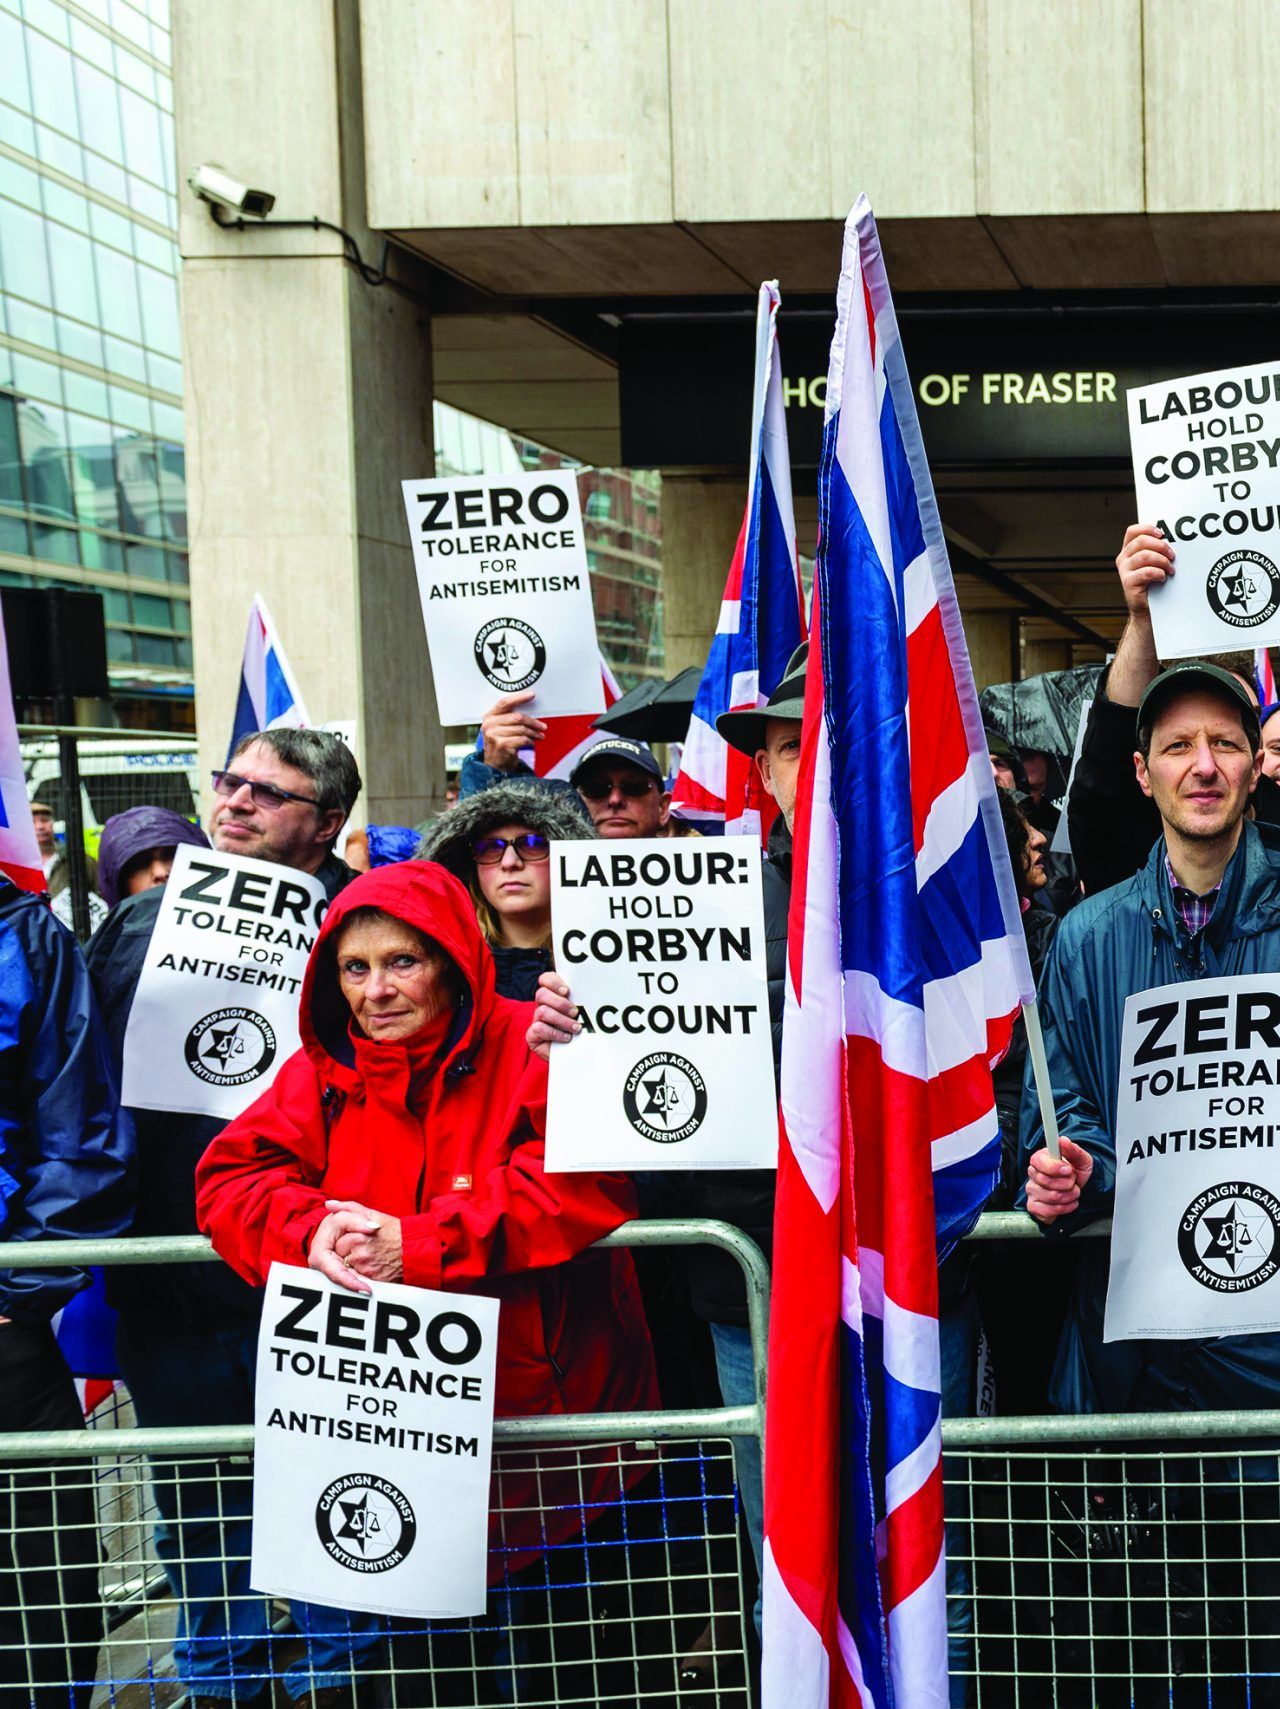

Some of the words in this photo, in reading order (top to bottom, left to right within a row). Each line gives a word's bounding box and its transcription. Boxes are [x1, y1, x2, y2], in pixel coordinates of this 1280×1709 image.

[919, 374, 970, 406] OF
[983, 372, 1117, 404] FRASER
[1188, 413, 1264, 442] HOLD
[1213, 480, 1251, 502] TO
[417, 484, 569, 532] ZERO
[422, 530, 575, 557] TOLERANCE
[480, 559, 516, 573] FOR
[1209, 552, 1244, 588] CAMPAIGN
[1246, 552, 1279, 579] AGAINST
[430, 576, 580, 600] ANTISEMITISM
[1219, 603, 1276, 626] ANTISEMITISM
[475, 619, 507, 653] CAMPAIGN
[509, 619, 542, 648] AGAINST
[487, 670, 540, 691] ANTISEMITISM
[560, 852, 748, 887] LABOUR:
[609, 896, 693, 919] HOLD
[174, 907, 314, 954] TOLERAN
[562, 927, 751, 963] CORBYN
[238, 946, 283, 966] FOR
[157, 954, 301, 994] ANTISEMIT
[638, 972, 678, 995] TO
[193, 1009, 246, 1037] CAMPAIGN
[247, 1013, 276, 1050] AGAINST
[576, 1005, 757, 1035] ACCOUNT
[190, 1060, 259, 1085] ANTISEMITISM
[626, 1054, 668, 1092] CAMPAIGN
[669, 1055, 705, 1092] AGAINST
[1209, 1097, 1264, 1117] FOR
[633, 1118, 699, 1141] ANTISEMITISM
[1183, 1184, 1239, 1231] CAMPAIGN
[1192, 1261, 1277, 1290] ANTISEMITISM
[274, 1284, 482, 1365] ZERO
[271, 1347, 481, 1401] TOLERANCE
[347, 1394, 397, 1417] FOR
[267, 1408, 478, 1457] ANTISEMITISM
[320, 1476, 372, 1511] CAMPAIGN
[374, 1480, 413, 1523] AGAINST
[325, 1541, 403, 1571] ANTISEMITISM
